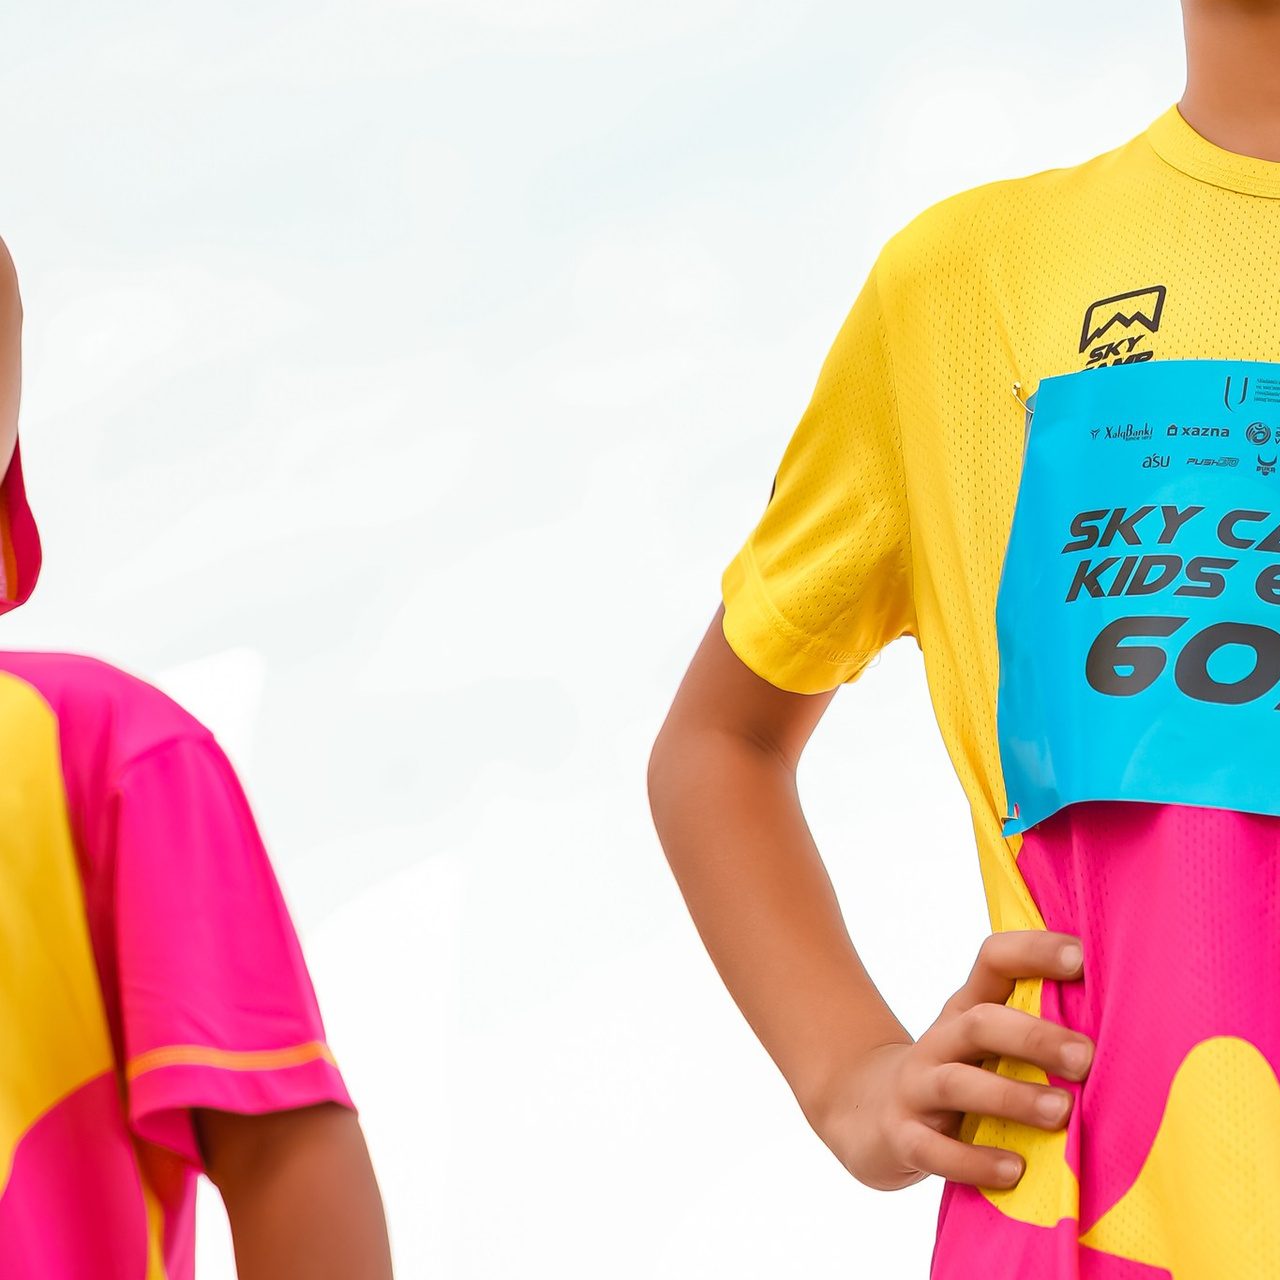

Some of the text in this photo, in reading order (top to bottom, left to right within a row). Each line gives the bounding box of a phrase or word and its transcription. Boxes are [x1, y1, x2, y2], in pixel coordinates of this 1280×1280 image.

[1086, 334, 1145, 366] SKY
[1181, 427, 1230, 437] xazna
[1061, 506, 1205, 554] SKY
[1065, 555, 1238, 602] KIDS
